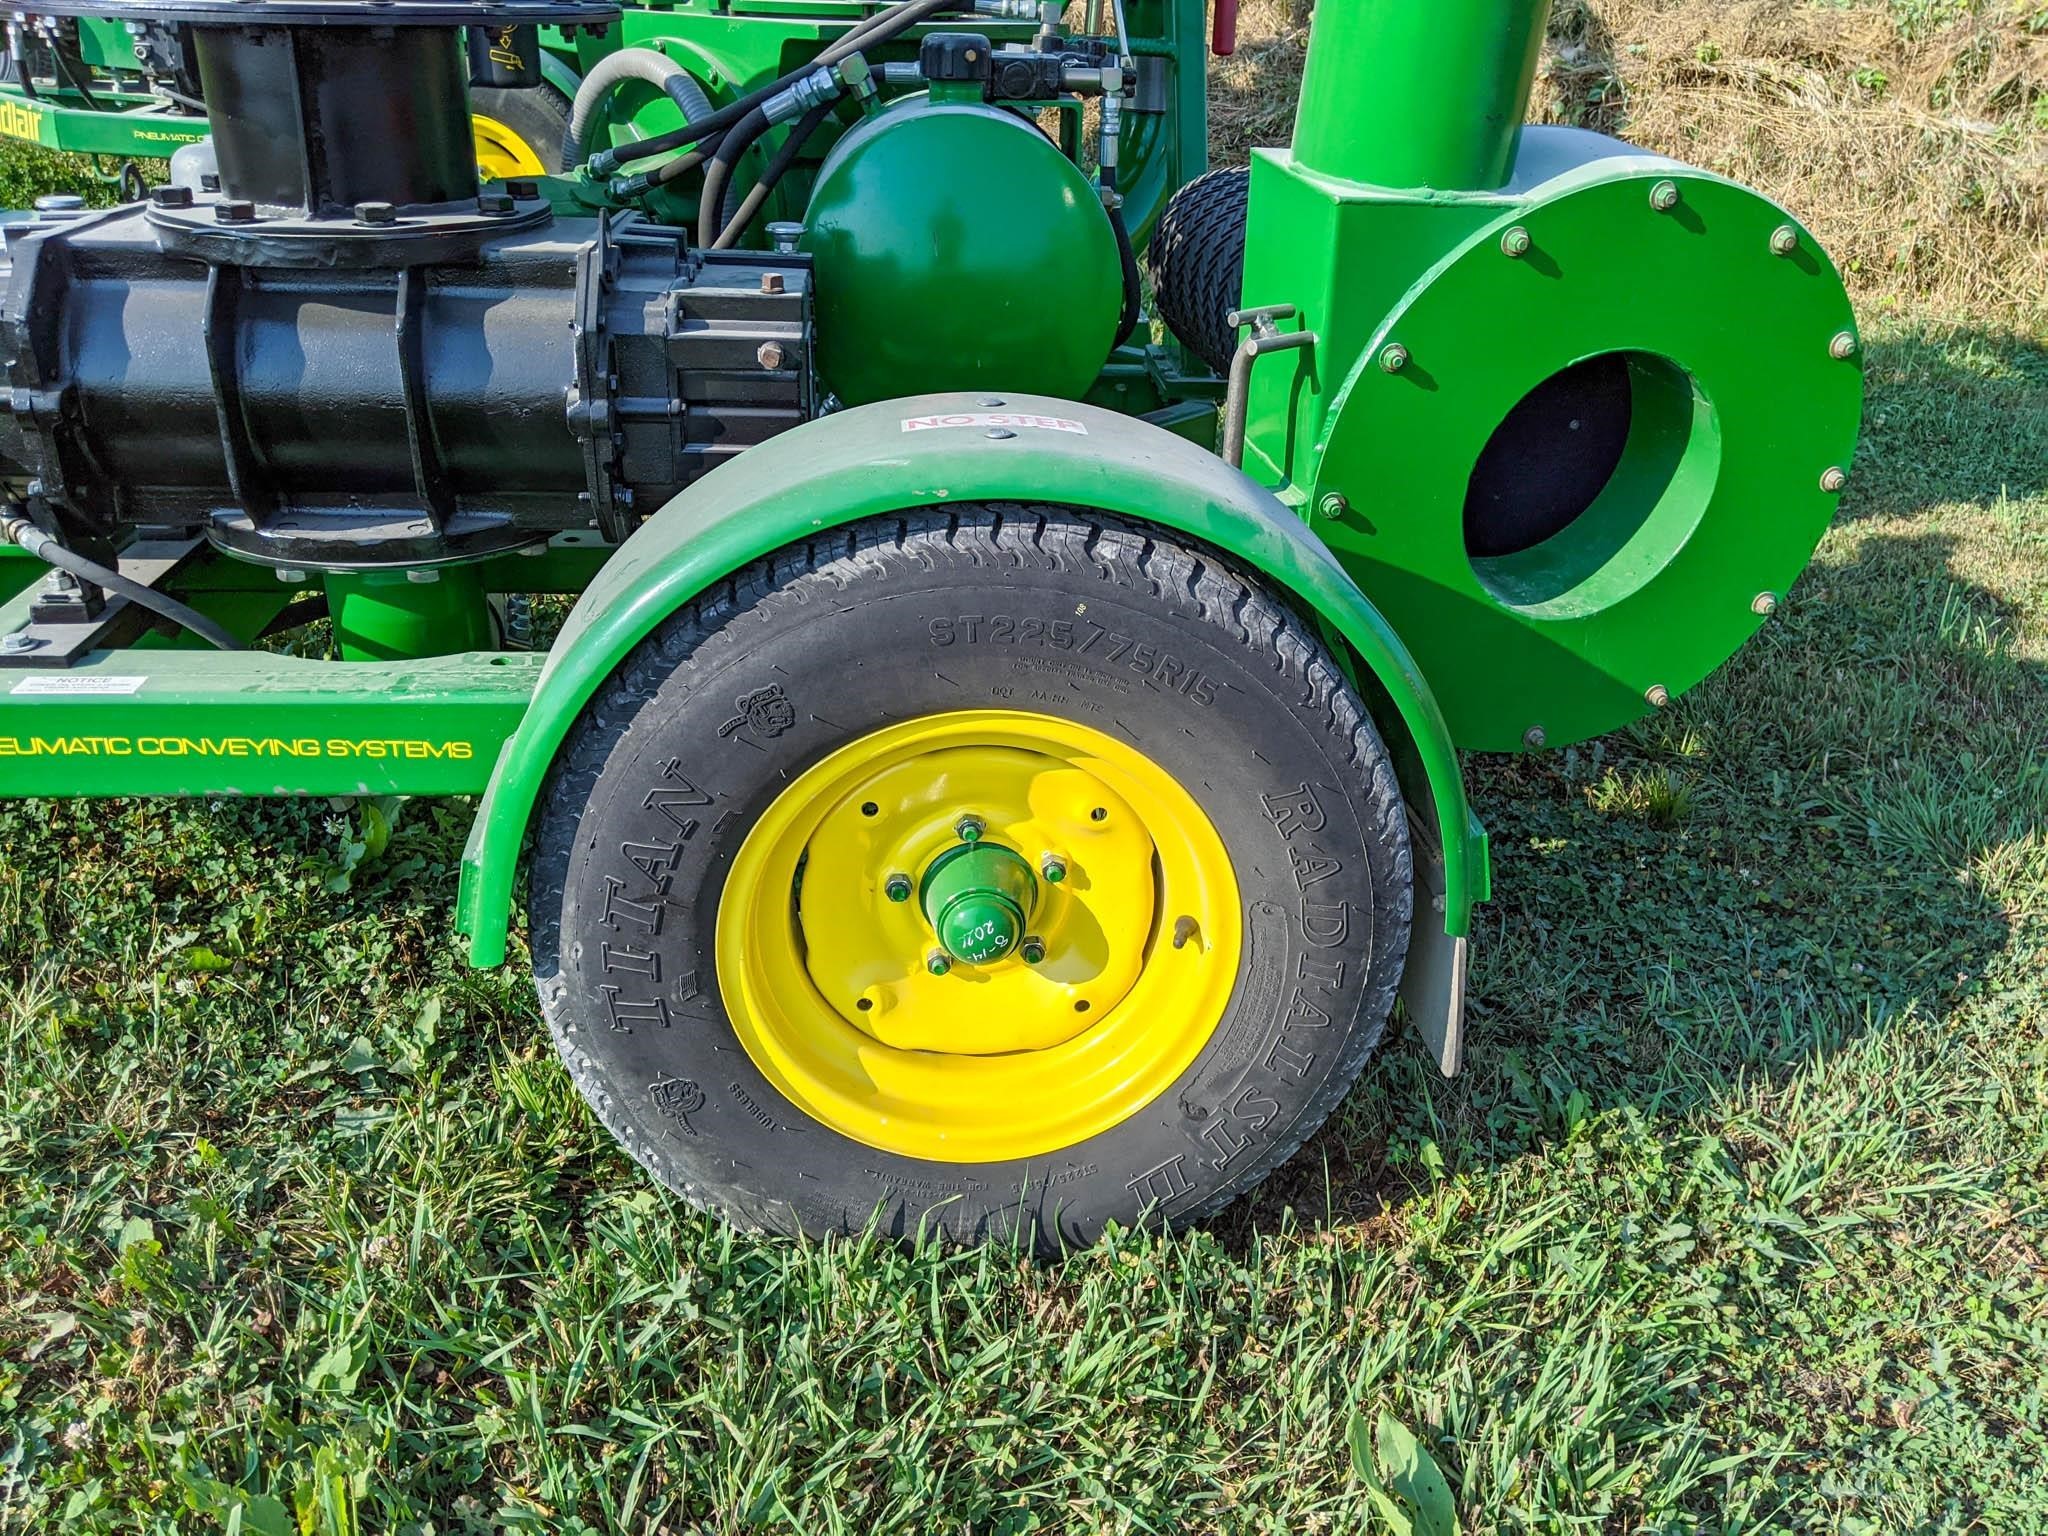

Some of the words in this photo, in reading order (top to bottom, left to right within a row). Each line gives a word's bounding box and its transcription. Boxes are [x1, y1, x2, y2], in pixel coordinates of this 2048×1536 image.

[133, 130, 196, 143] PNEUMATIC
[907, 416, 975, 430] NO
[988, 414, 1081, 432] STEP
[928, 613, 1221, 707] ST225/75R15
[137, 736, 321, 757] CONVEYING
[327, 739, 473, 759] SYSTEMS
[599, 756, 715, 1034] TITAN
[1260, 782, 1349, 1079] RADIAL
[727, 1081, 778, 1134] TUBELESS
[1201, 1086, 1281, 1171] ST
